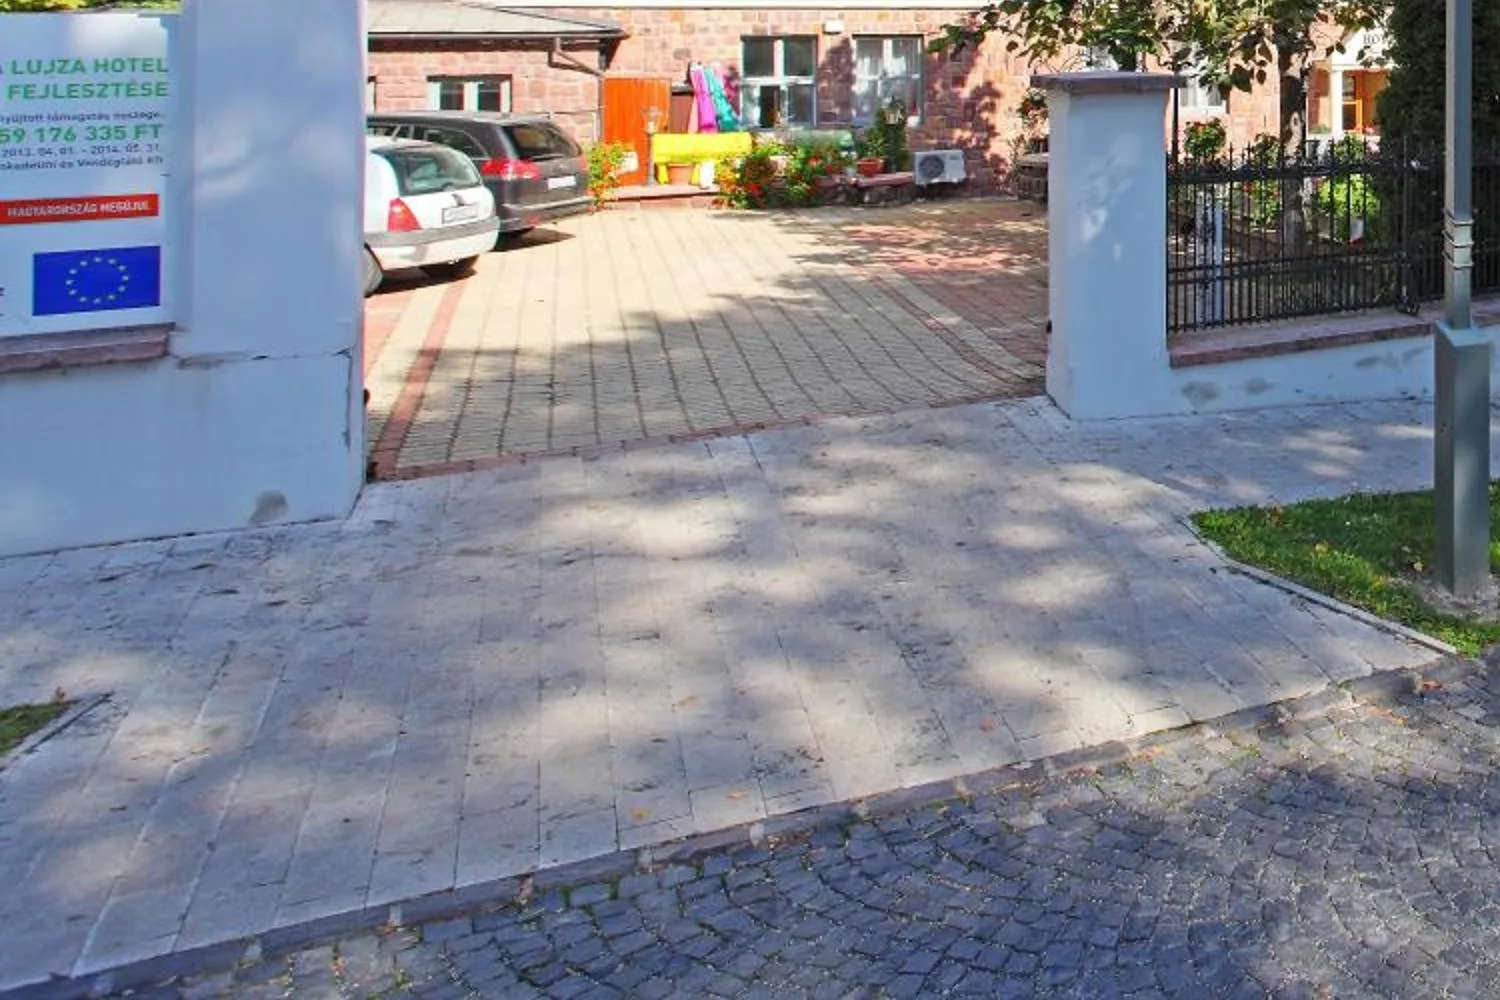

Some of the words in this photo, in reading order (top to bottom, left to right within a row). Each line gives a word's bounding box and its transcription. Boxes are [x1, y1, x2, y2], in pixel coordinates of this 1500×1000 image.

[11, 59, 86, 75] LUJZA
[94, 57, 169, 73] HOTEL
[7, 78, 169, 100] FEJLESZTÉSE
[33, 126, 77, 143] 176
[85, 125, 127, 141] 335
[133, 123, 163, 140] FT
